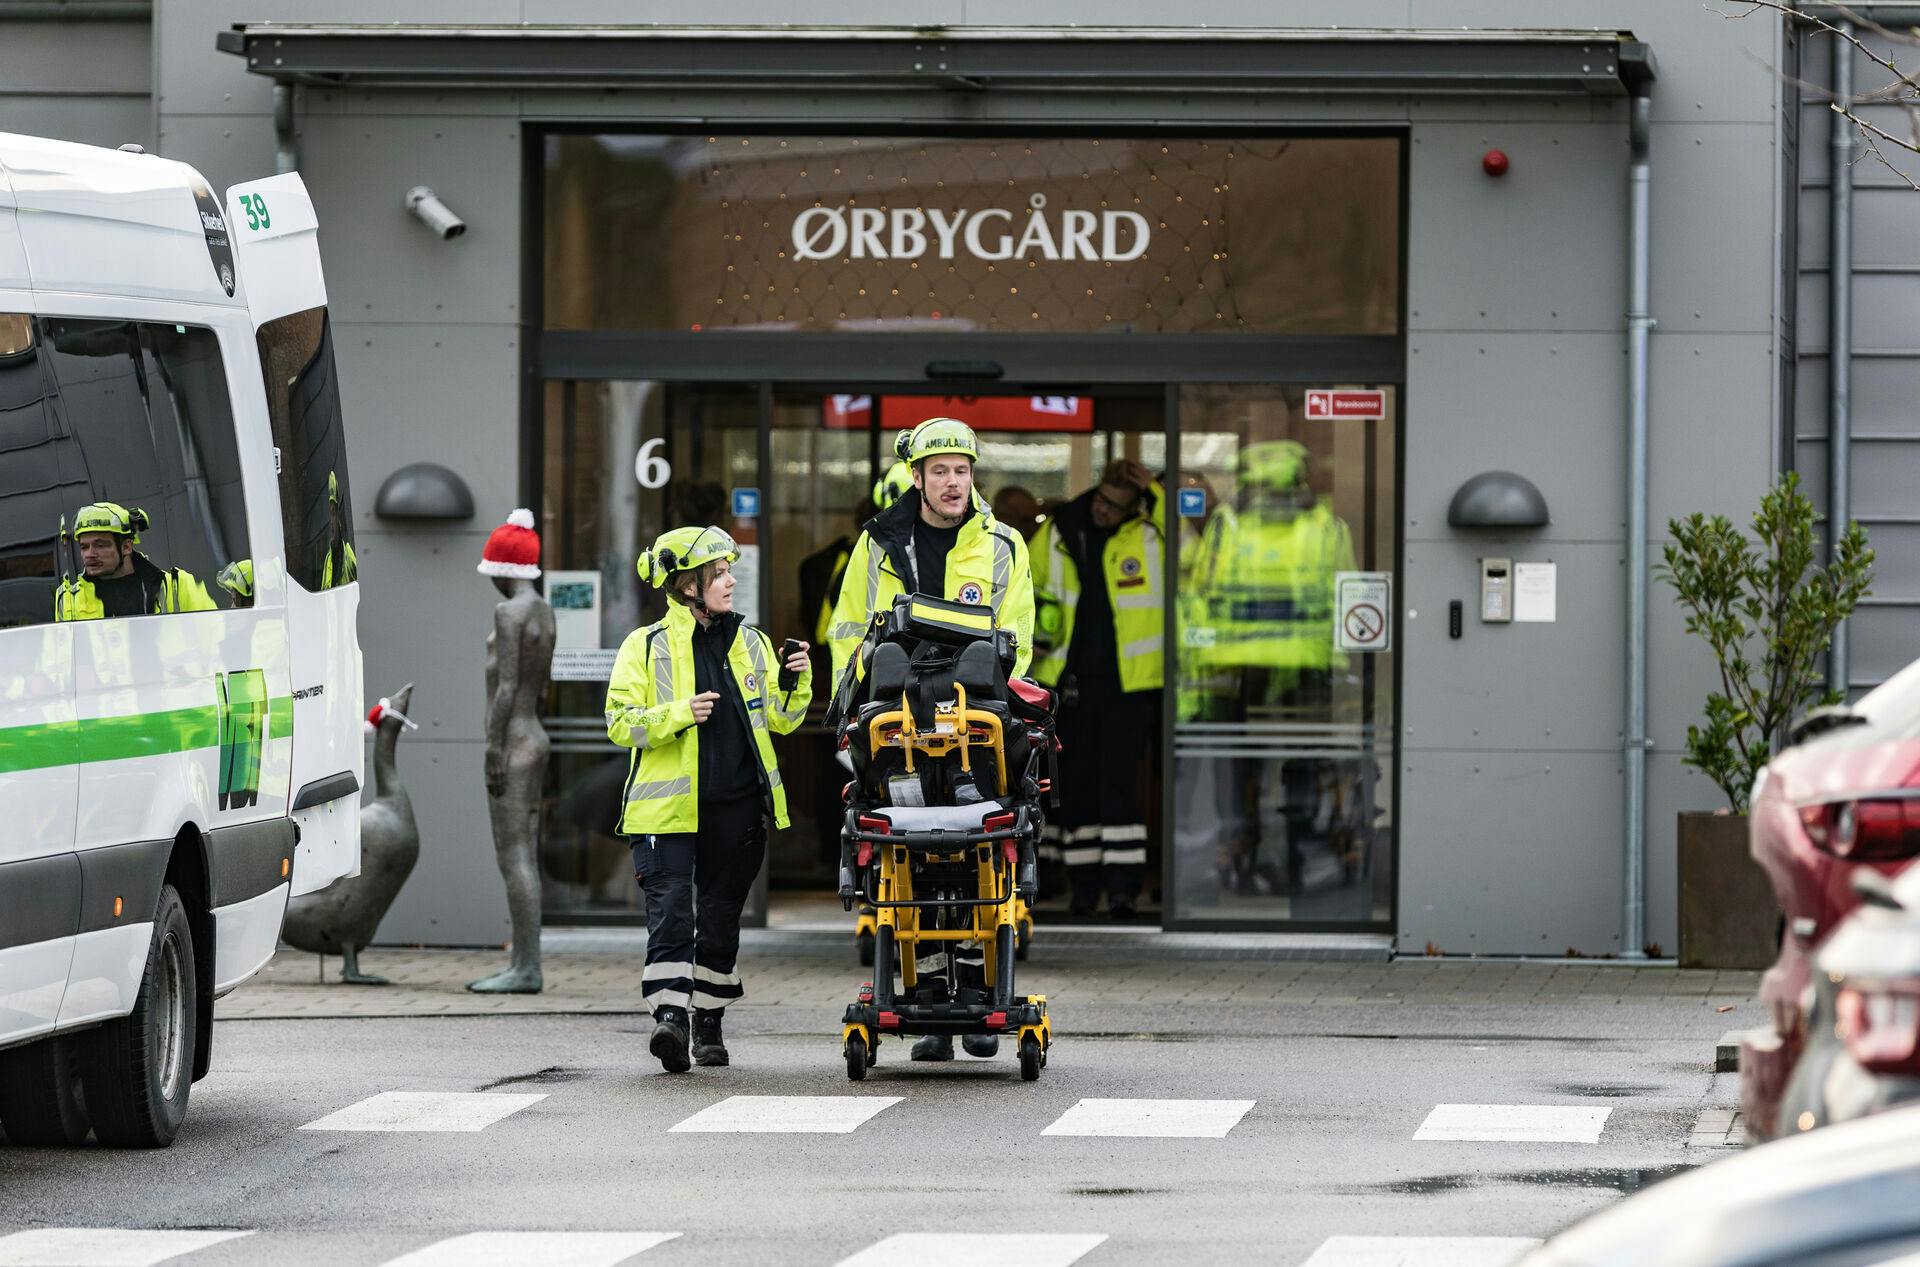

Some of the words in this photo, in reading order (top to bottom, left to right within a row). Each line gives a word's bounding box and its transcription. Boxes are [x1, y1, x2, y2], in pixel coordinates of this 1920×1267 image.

[238, 192, 271, 231] 39
[791, 192, 1151, 262] ØRBYGÅRD
[634, 437, 671, 489] 6
